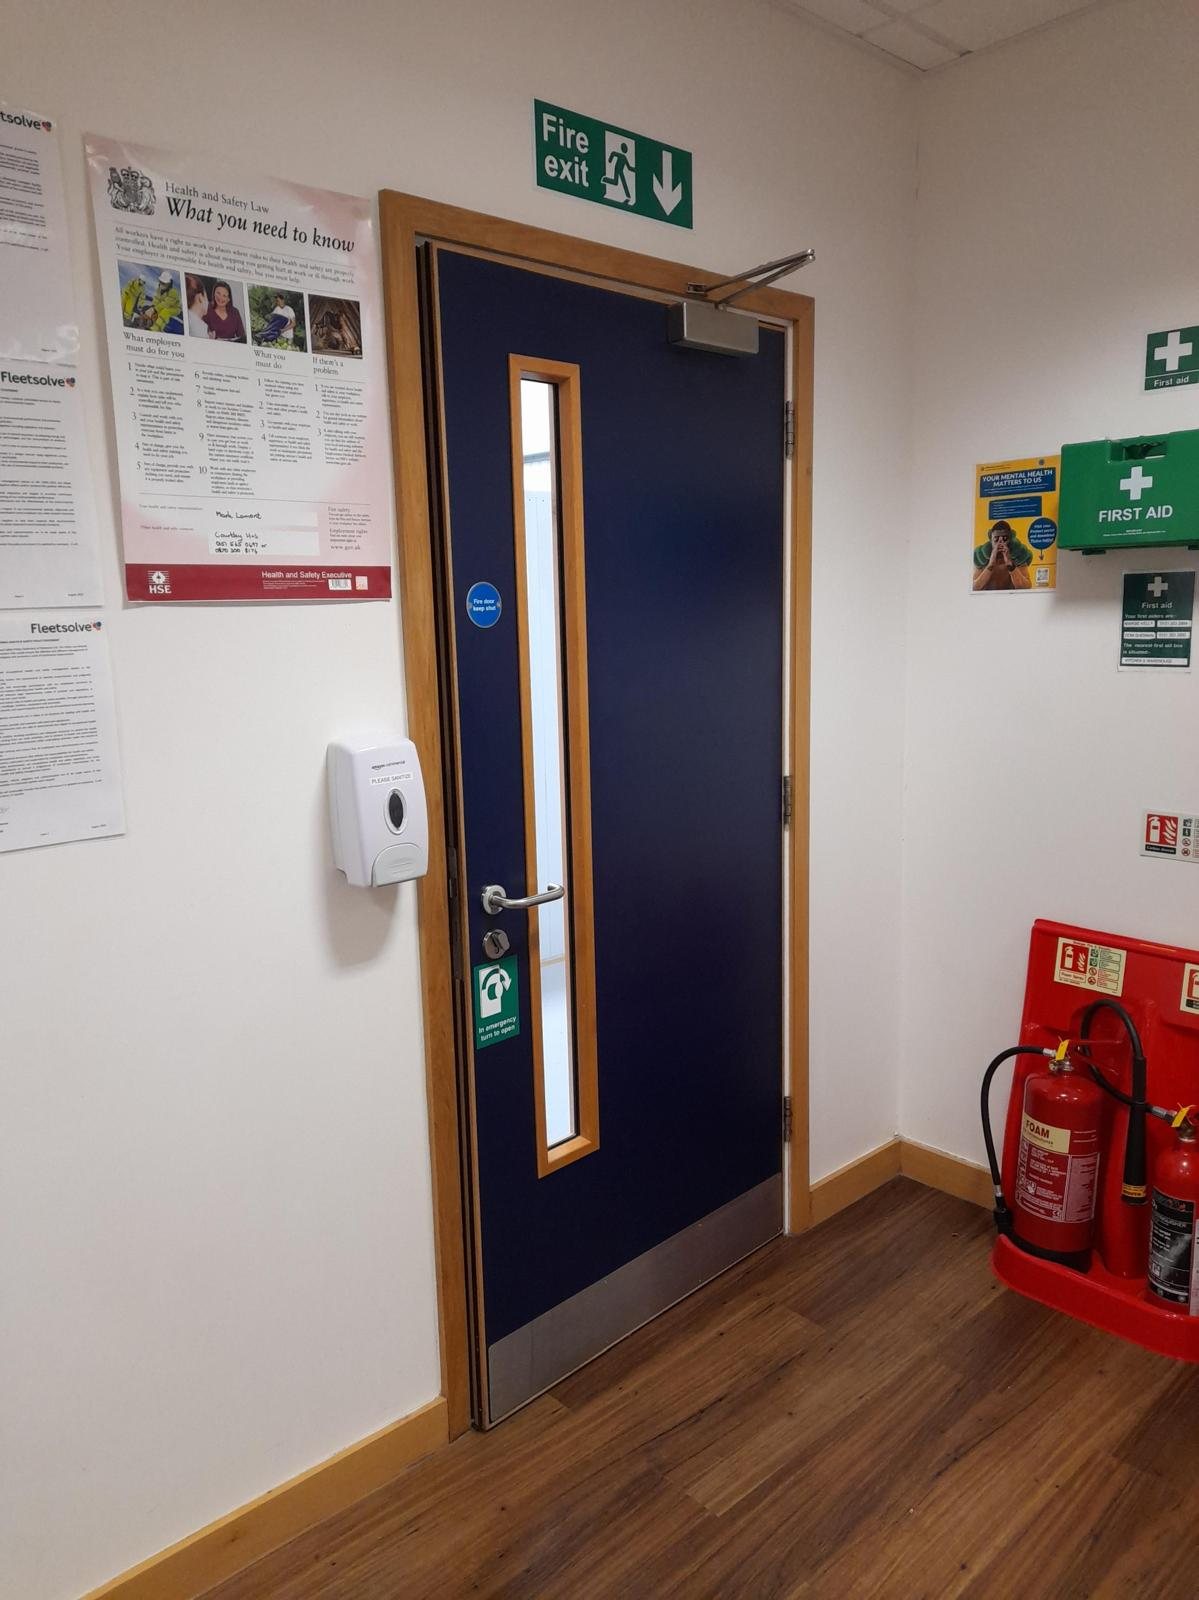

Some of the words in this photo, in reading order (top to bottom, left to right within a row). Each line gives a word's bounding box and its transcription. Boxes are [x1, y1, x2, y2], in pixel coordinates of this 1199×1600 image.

[542, 112, 589, 154] Fire
[544, 154, 589, 188] exit
[165, 181, 199, 198] Health
[202, 191, 219, 202] and
[222, 194, 248, 210] Safety
[251, 201, 269, 214] Law
[166, 196, 213, 223] What
[217, 212, 247, 231] you
[253, 220, 287, 239] need
[293, 226, 307, 243] to
[313, 228, 354, 252] know
[123, 331, 144, 342] What
[146, 338, 181, 347] employers
[126, 344, 144, 352] must
[254, 350, 272, 359] What
[313, 367, 339, 375] problem
[1, 371, 65, 387] Fleetsolve
[1154, 378, 1172, 387] First
[1176, 376, 1189, 384] aid
[1028, 469, 1053, 478] HEALTH
[993, 479, 1022, 487] MATTERS
[1099, 507, 1142, 522] FIRST
[1146, 505, 1173, 519] AID
[300, 571, 320, 579] Safety
[149, 585, 172, 593] HSE
[31, 622, 92, 634] Fleetsolve
[372, 776, 390, 784] PLEASE
[485, 1016, 516, 1031] emergency
[480, 1032, 492, 1041] turn
[501, 1025, 515, 1035] open
[1026, 1120, 1050, 1139] FOAM
